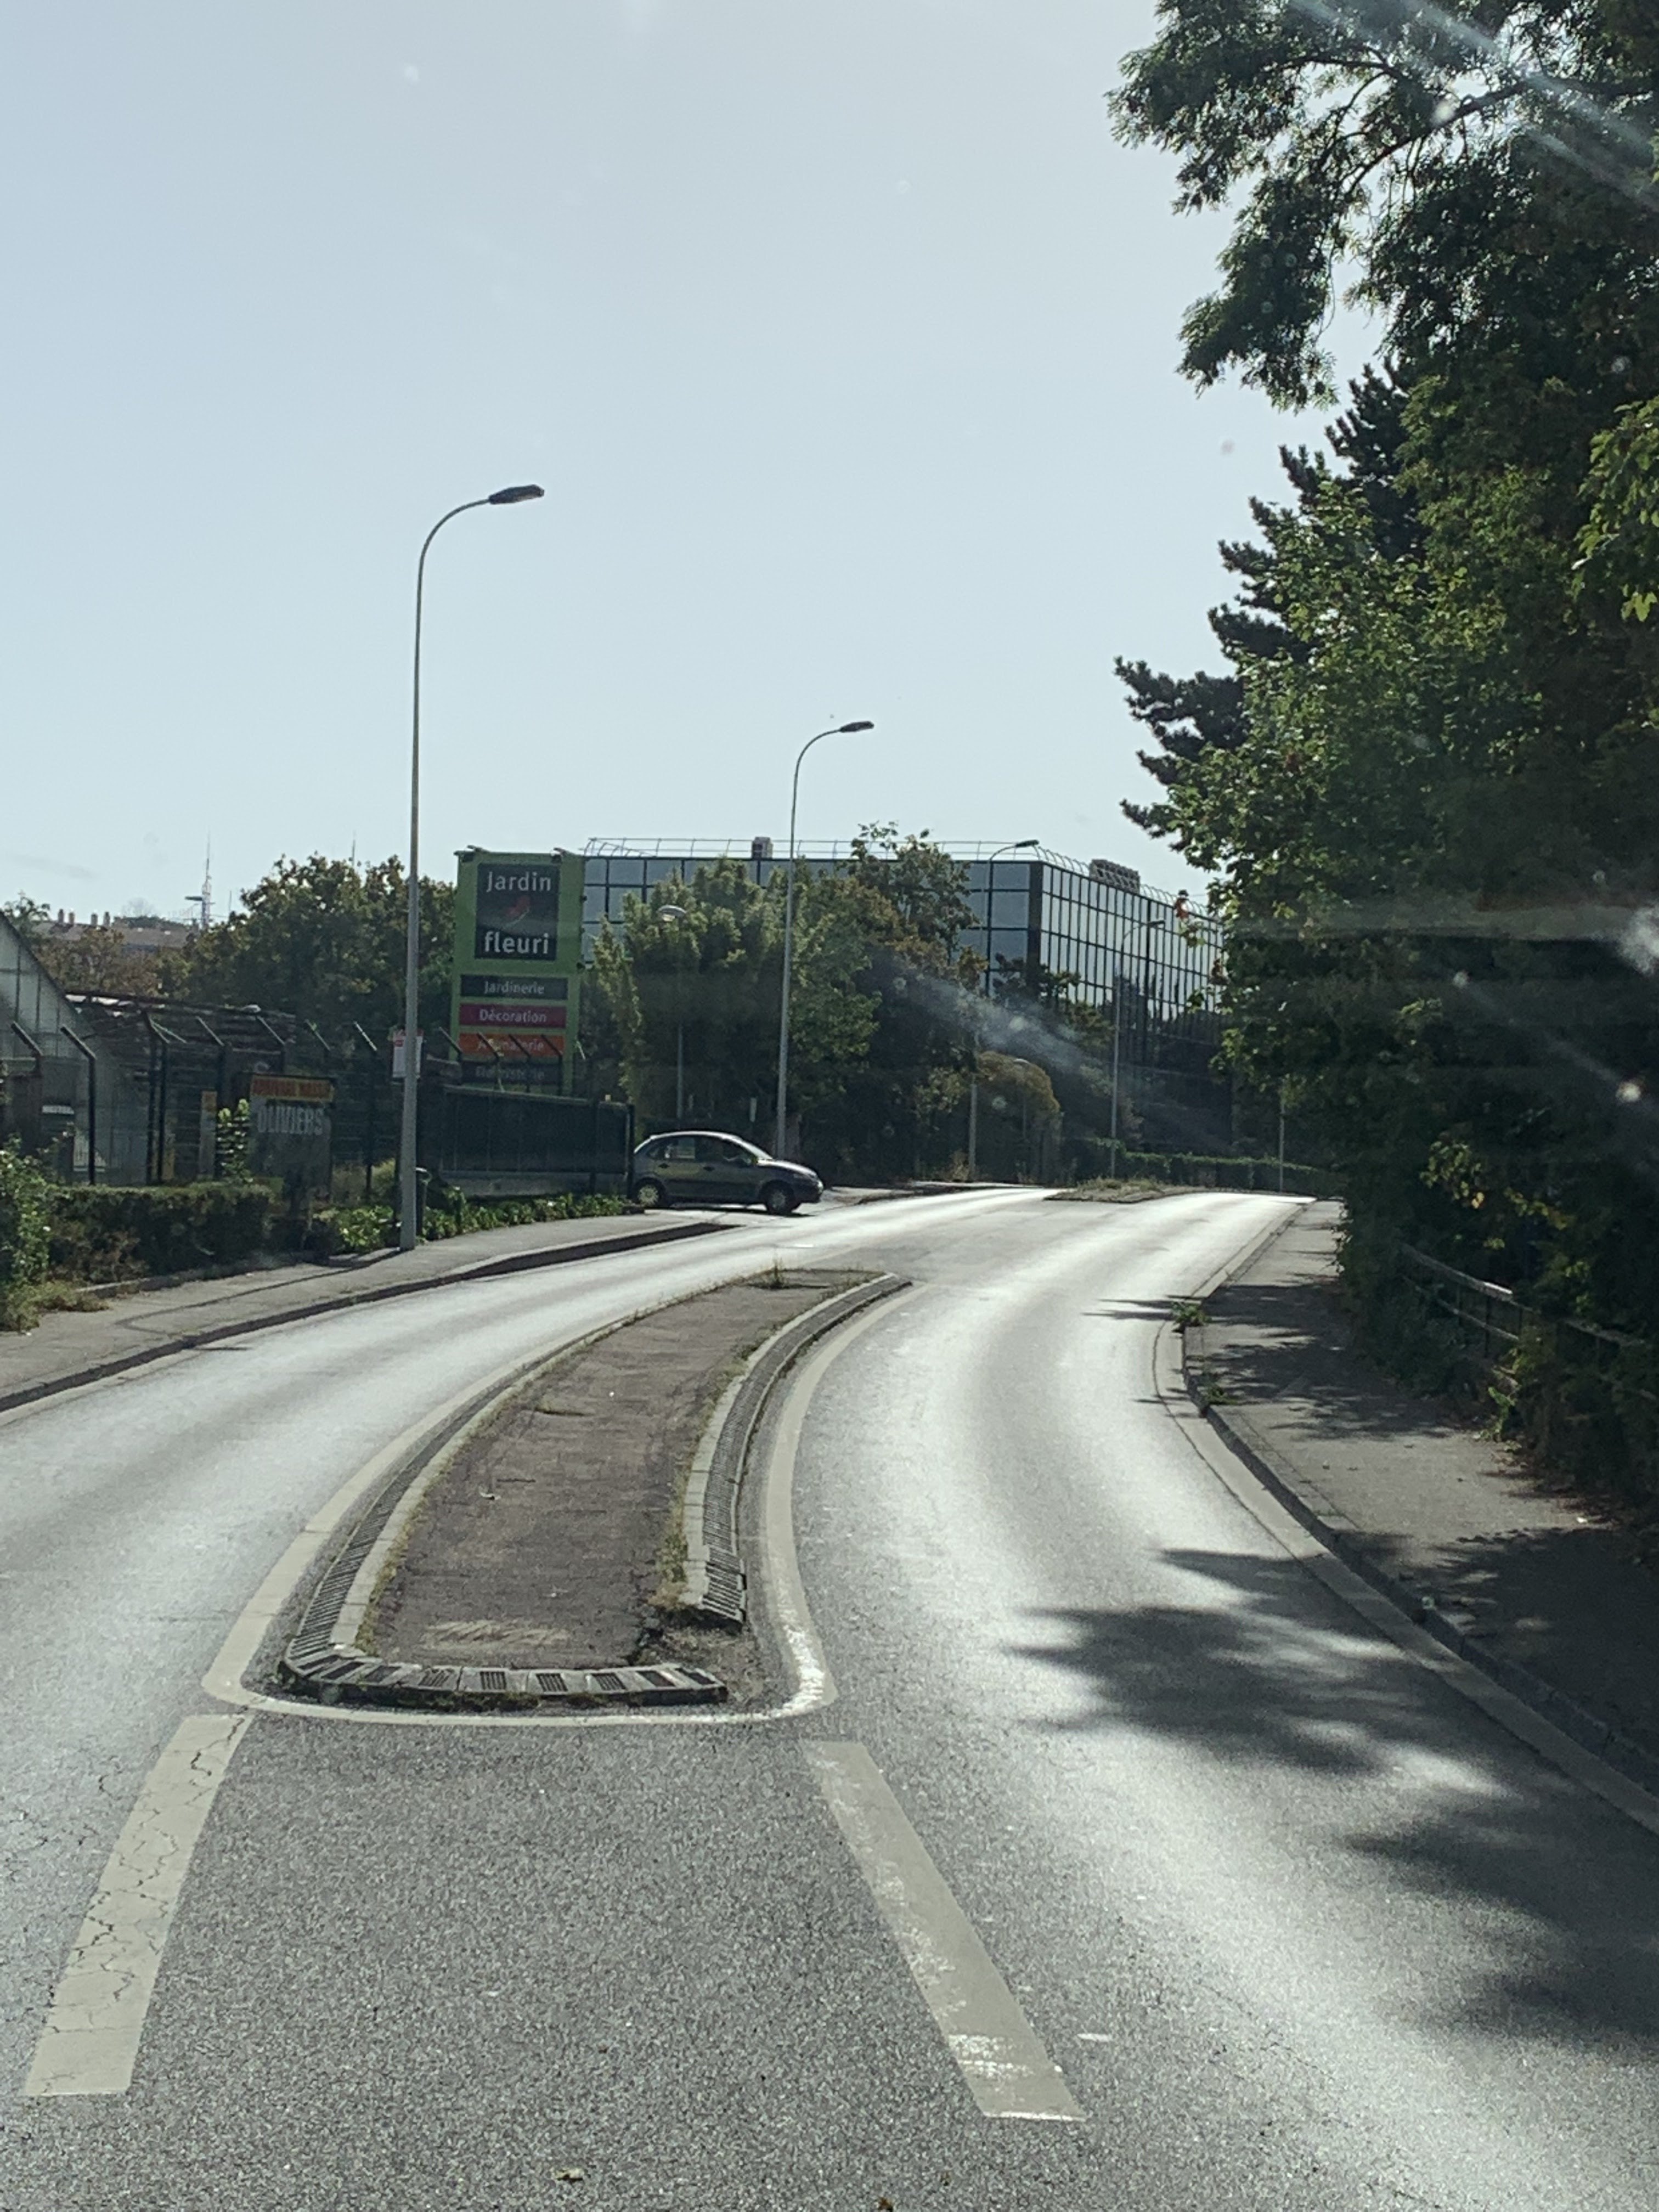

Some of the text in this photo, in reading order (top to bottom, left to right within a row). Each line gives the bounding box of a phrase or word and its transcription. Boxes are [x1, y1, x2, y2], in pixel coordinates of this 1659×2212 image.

[486, 871, 551, 892] Jardin
[485, 931, 549, 954] fleuri
[484, 981, 545, 994] Jardinerie
[479, 1006, 547, 1023] Décoration
